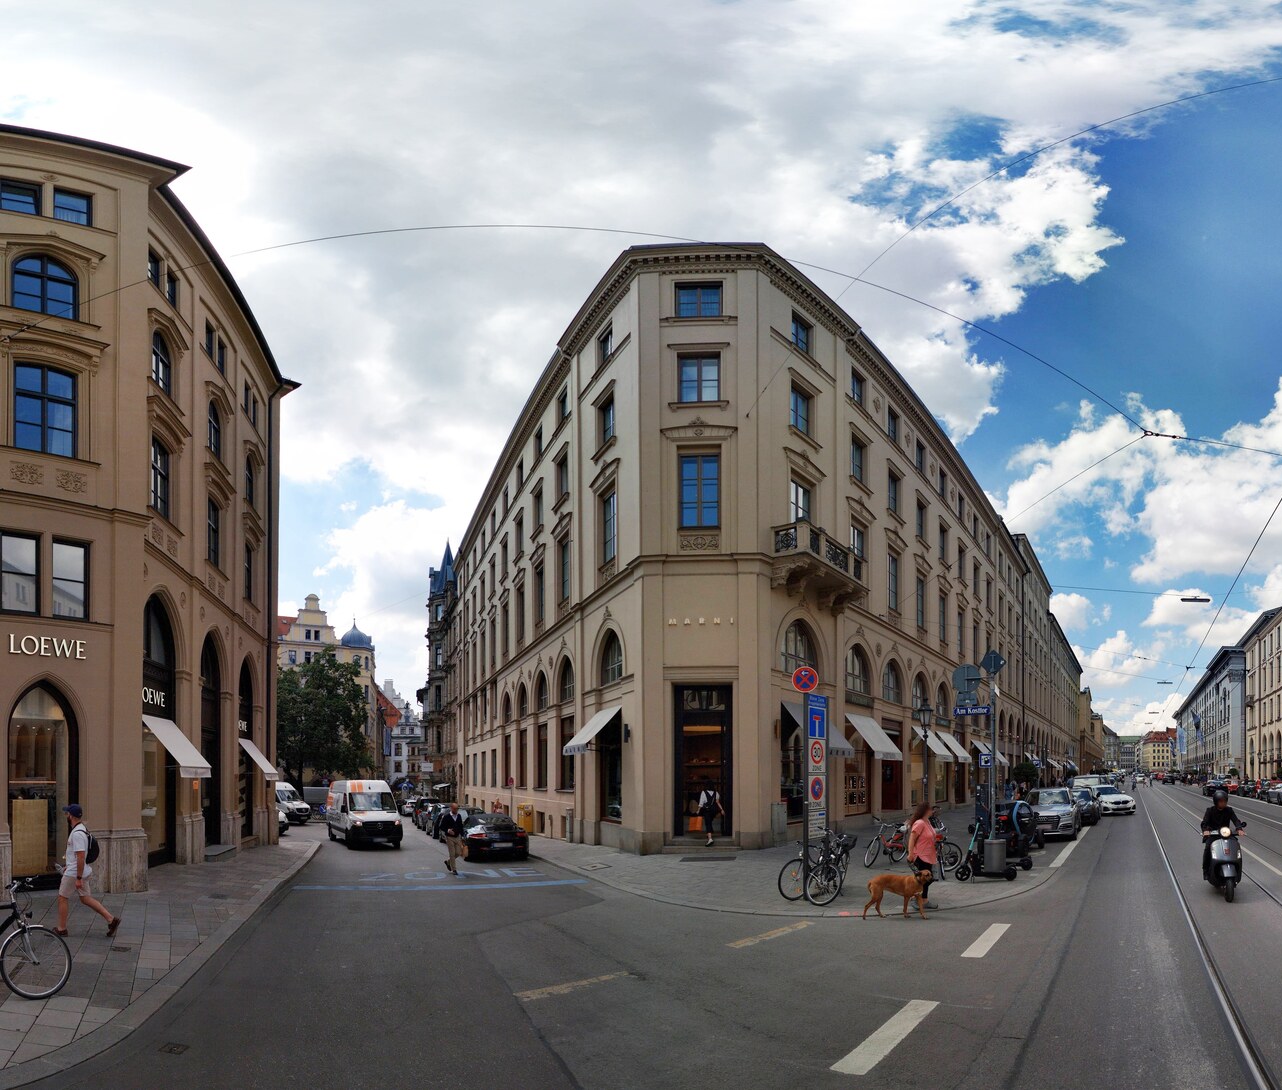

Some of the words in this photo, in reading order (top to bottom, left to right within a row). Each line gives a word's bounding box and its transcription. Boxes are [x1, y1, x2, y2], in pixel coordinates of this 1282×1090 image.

[668, 617, 734, 626] MARNI
[9, 633, 87, 660] LOEWE
[141, 686, 166, 708] OEWE
[955, 707, 966, 715] Am
[238, 719, 248, 732] EWE
[359, 867, 546, 881] ZONE
